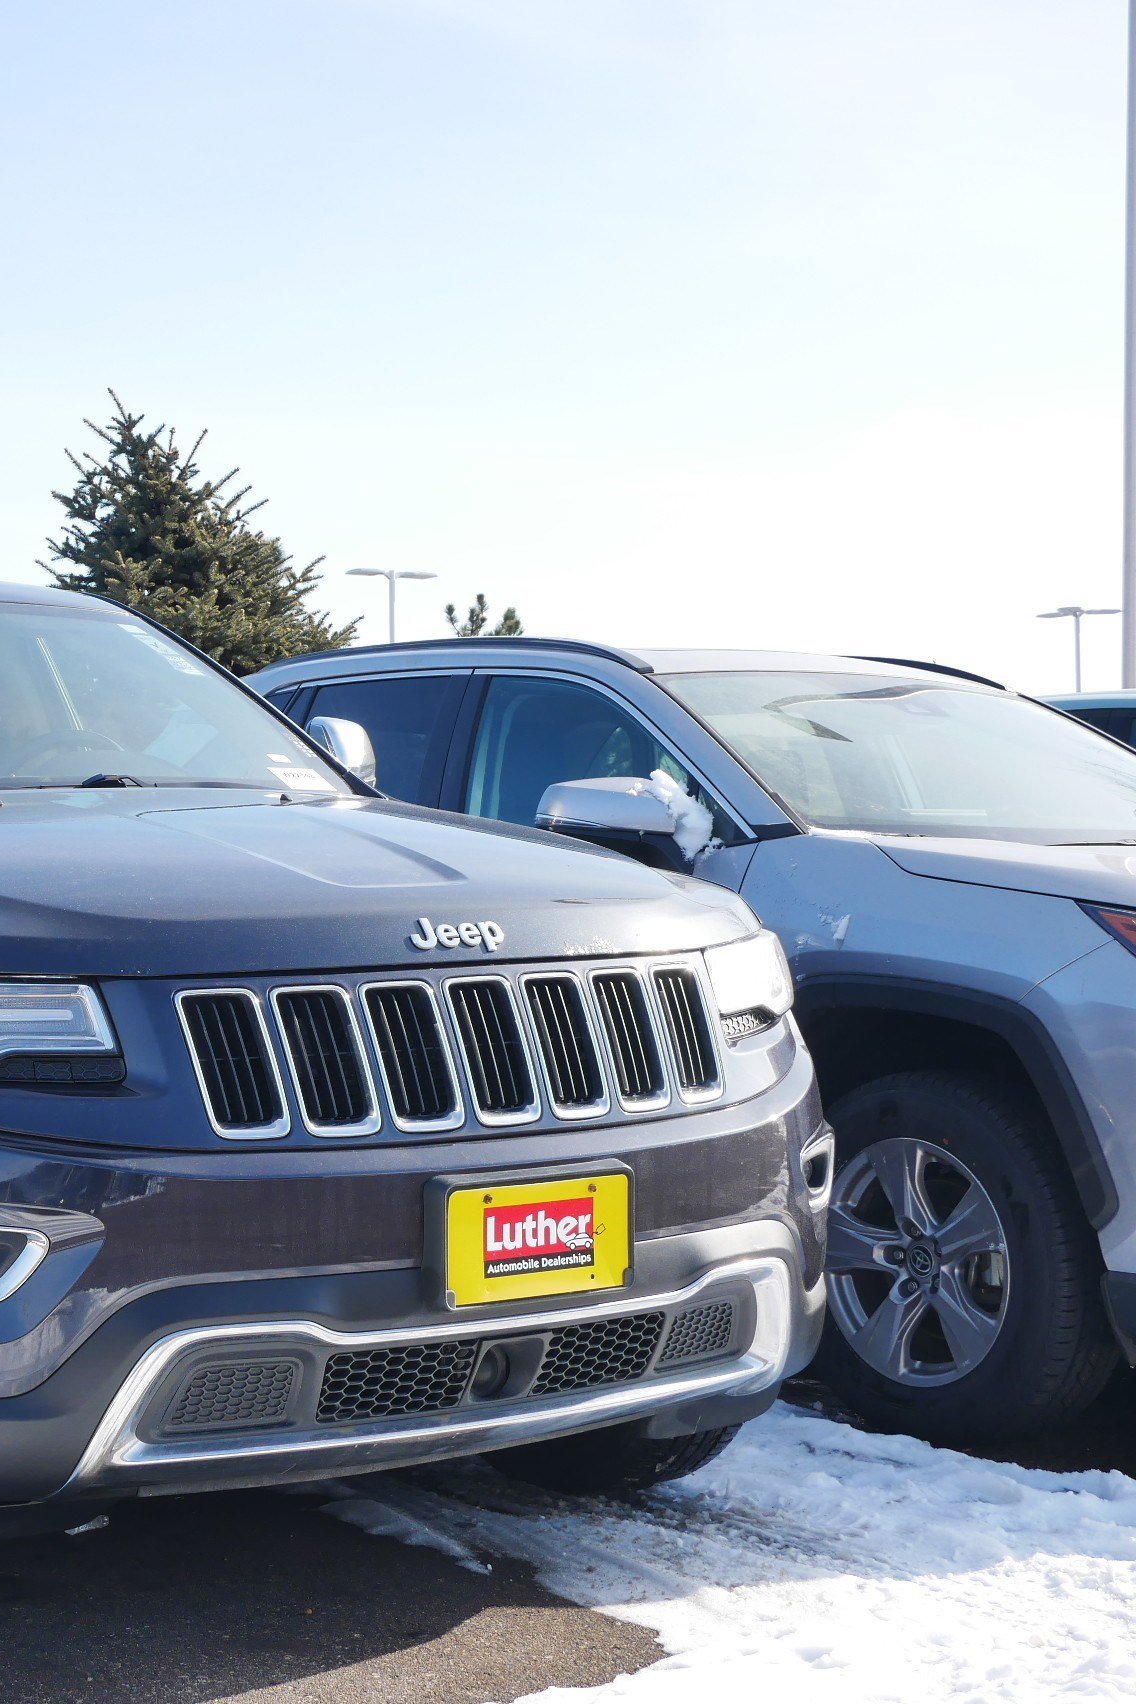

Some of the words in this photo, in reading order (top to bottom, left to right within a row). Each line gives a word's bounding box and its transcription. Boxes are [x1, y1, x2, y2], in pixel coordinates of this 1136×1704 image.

[409, 917, 505, 952] Jeep
[486, 1209, 592, 1252] Luther
[487, 1258, 540, 1274] Automobile
[541, 1253, 592, 1268] Dealerships
